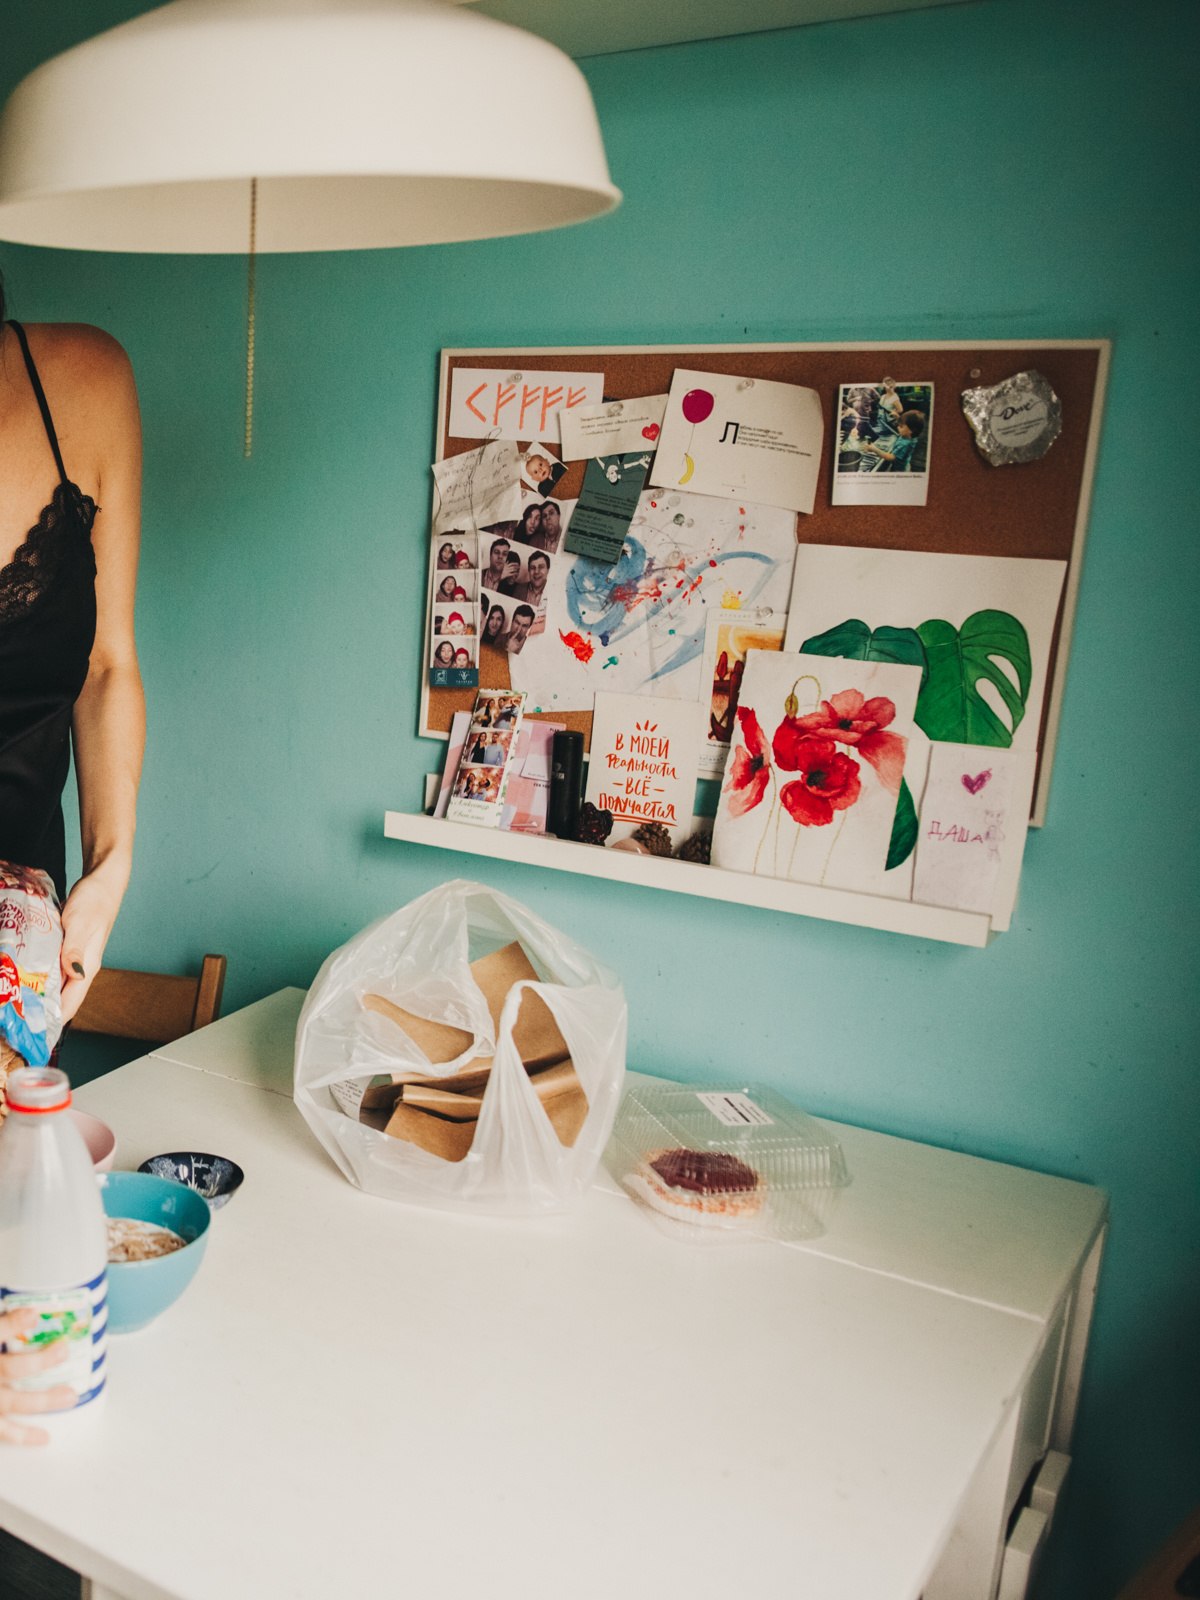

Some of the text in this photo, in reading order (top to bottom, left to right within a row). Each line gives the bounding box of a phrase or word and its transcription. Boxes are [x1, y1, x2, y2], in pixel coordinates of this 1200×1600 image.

[615, 733, 670, 760] В МОЕЙ
[625, 775, 652, 797] ВСЁ
[927, 820, 984, 844] ДАША
